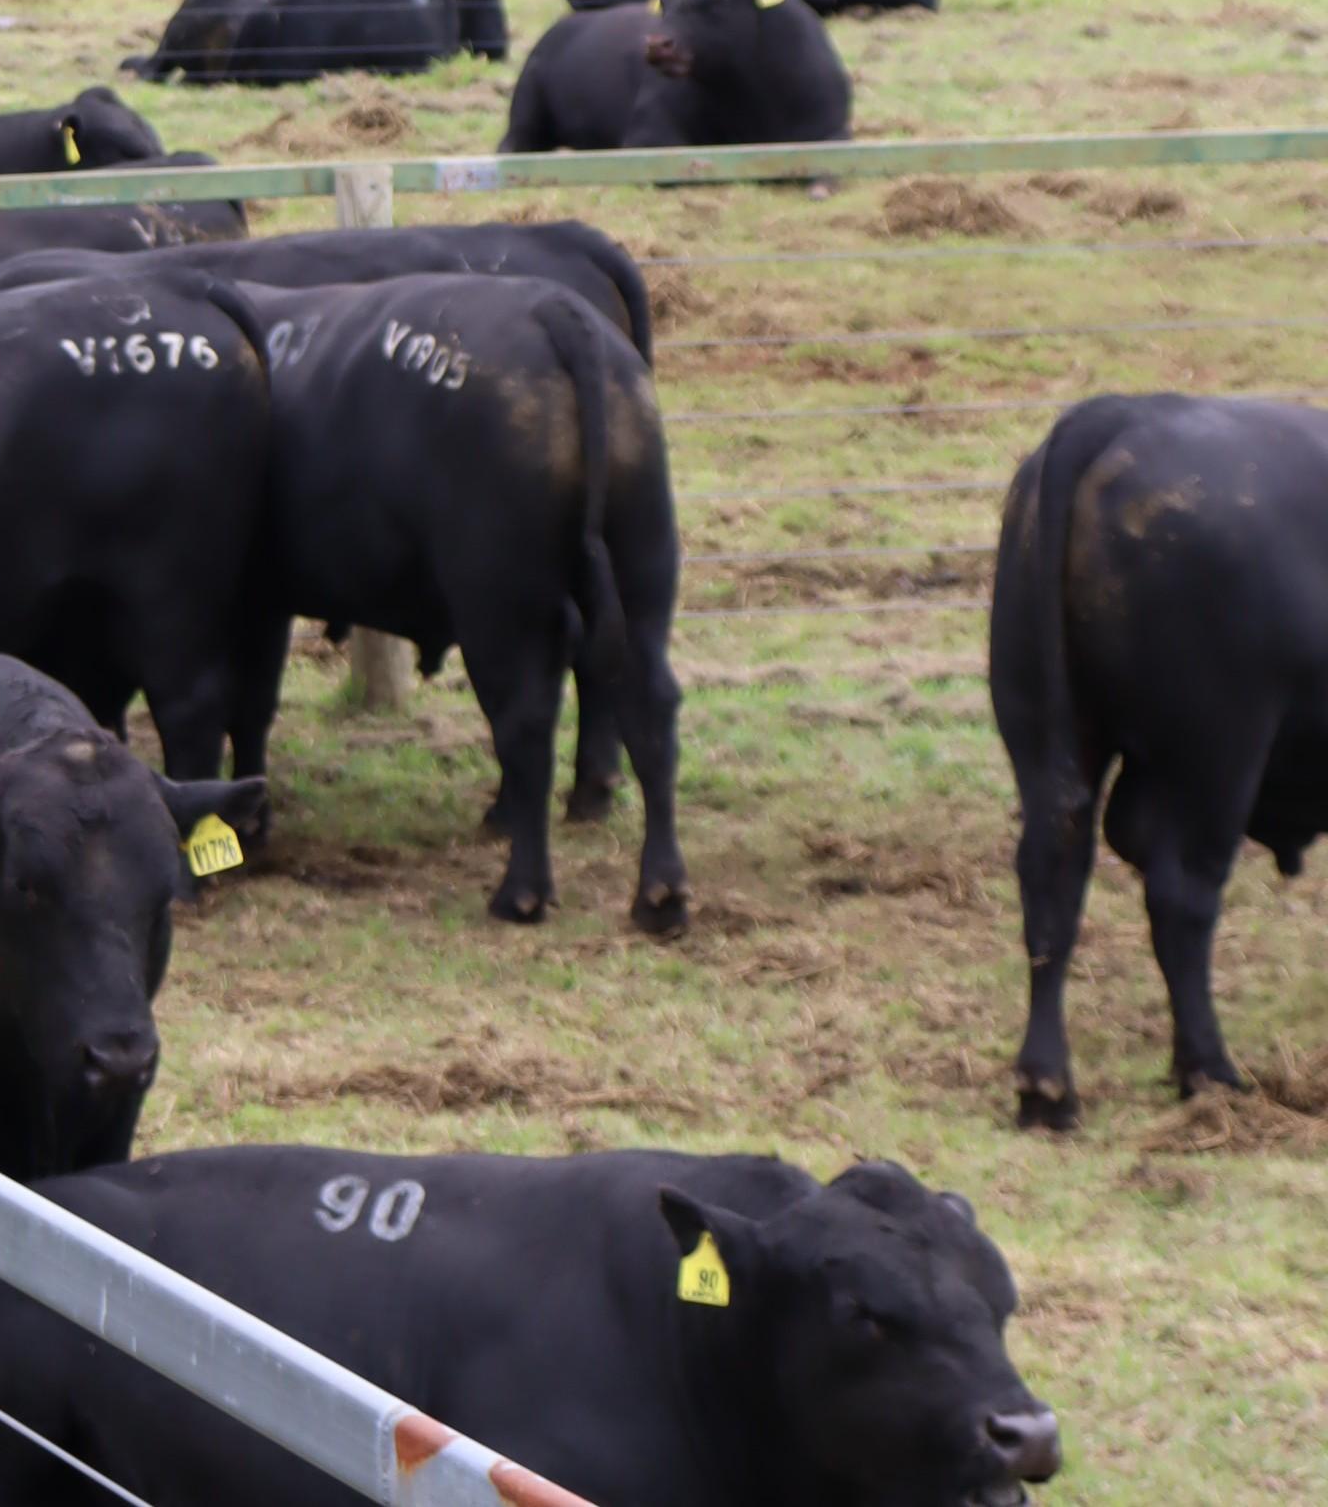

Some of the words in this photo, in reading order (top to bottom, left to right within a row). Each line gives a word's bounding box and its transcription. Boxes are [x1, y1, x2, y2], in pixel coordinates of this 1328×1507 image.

[60, 331, 219, 377] V1676
[314, 1174, 426, 1242] 90
[698, 1268, 719, 1293] 90
